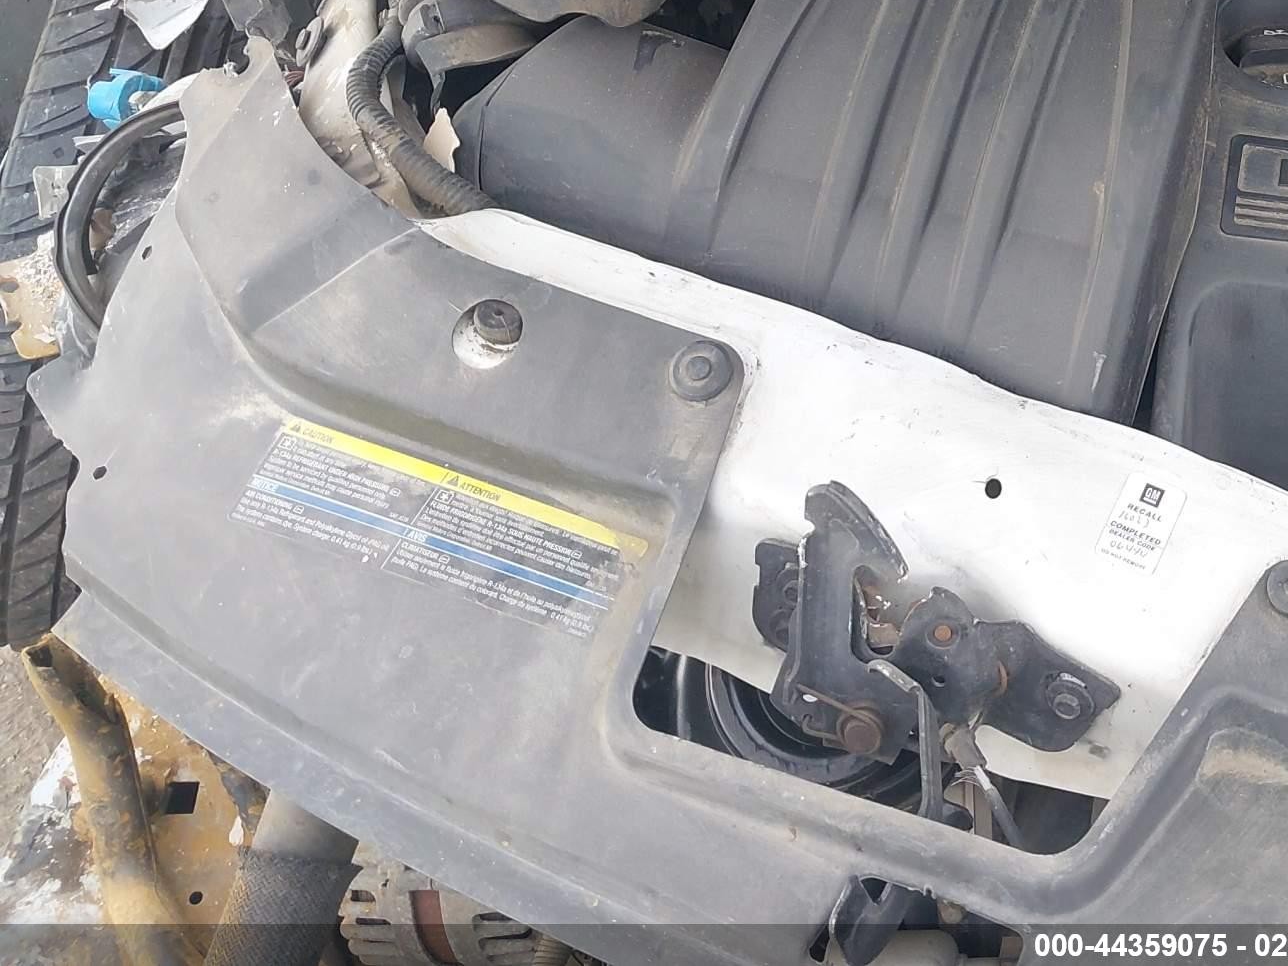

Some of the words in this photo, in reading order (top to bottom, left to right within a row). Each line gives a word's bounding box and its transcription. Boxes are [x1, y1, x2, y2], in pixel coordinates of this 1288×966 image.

[303, 428, 334, 443] CAUTION
[460, 482, 501, 502] ATTENTION
[1127, 503, 1162, 522] RECALL
[406, 530, 428, 542] AVIS
[1108, 528, 1135, 543] DEALER
[1136, 540, 1156, 551] CODE
[1110, 520, 1161, 545] COMPLETED
